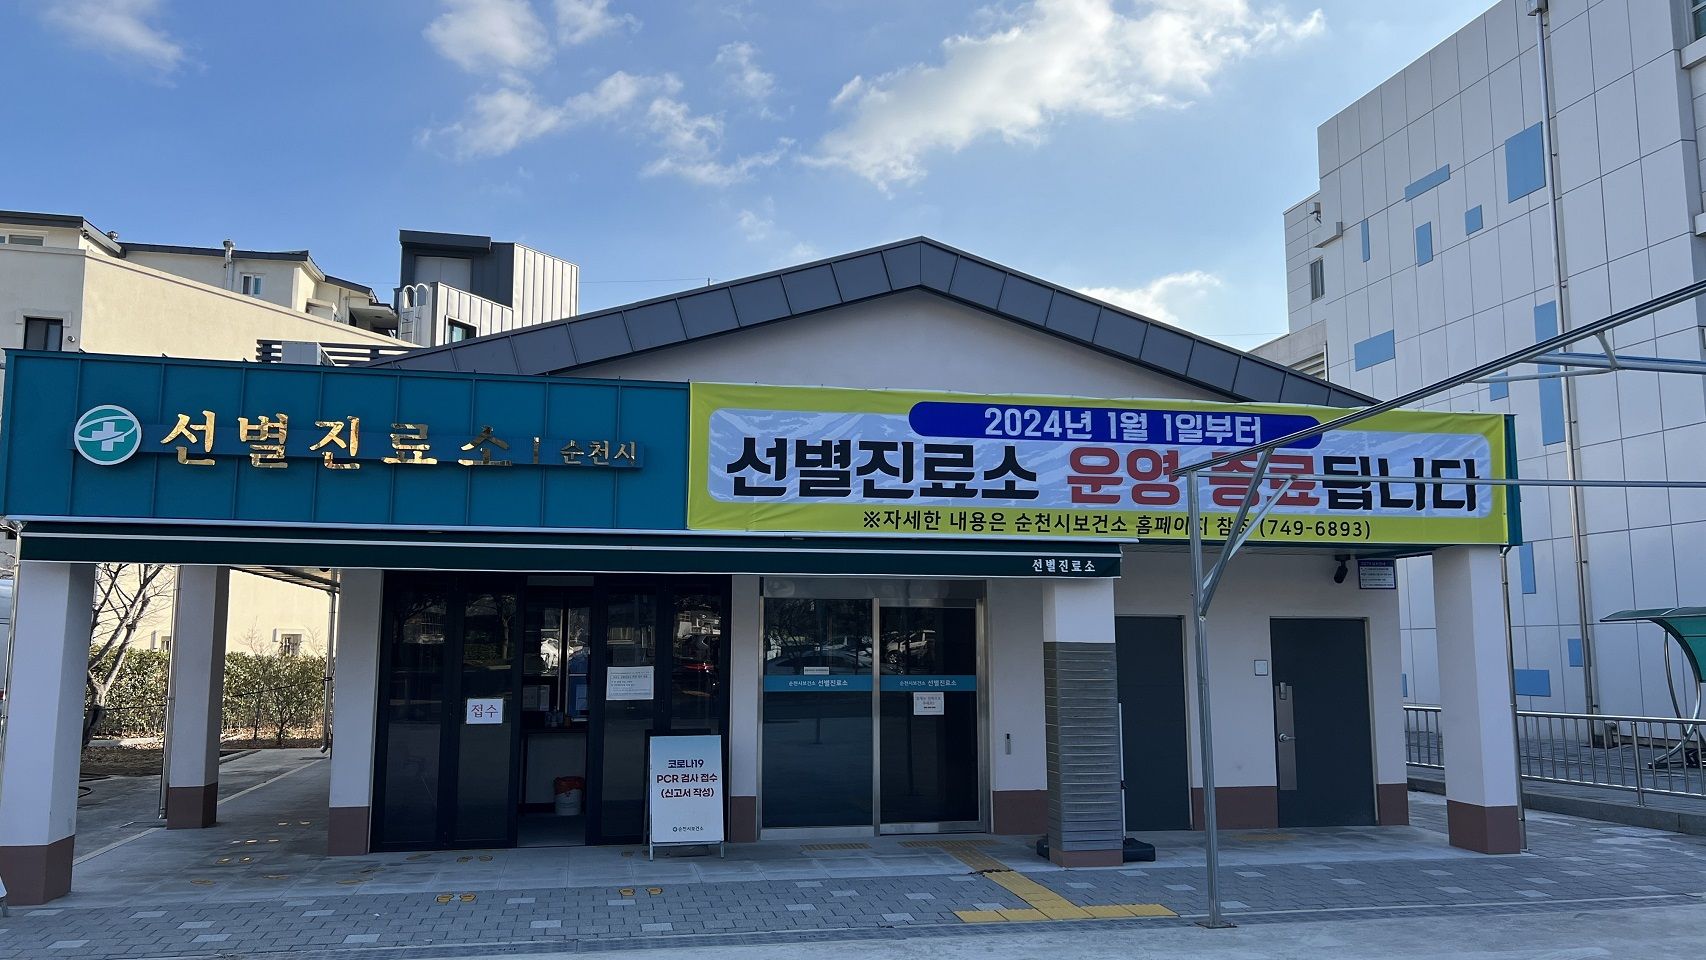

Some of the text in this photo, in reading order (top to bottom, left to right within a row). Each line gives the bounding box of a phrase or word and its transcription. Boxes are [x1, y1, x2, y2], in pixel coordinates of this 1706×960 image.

[985, 407, 1262, 445] 2024년 1월 1일부터
[159, 409, 636, 470] 선별진료소 순천시
[726, 436, 1039, 500] 선별진료소
[1067, 446, 1180, 505] 운영
[950, 511, 1007, 532] 내용은
[1014, 513, 1128, 535] 순천시보건소
[1259, 519, 1371, 540] (749-6893)
[1032, 558, 1096, 573] 선별진료소
[818, 679, 848, 687] 선별진료소
[927, 679, 957, 687] 선별진료소
[471, 703, 499, 718] 접수
[668, 759, 705, 769] 코로나19
[656, 773, 718, 783] PCR 검사 접수
[660, 787, 714, 798] (신고서 작성)
